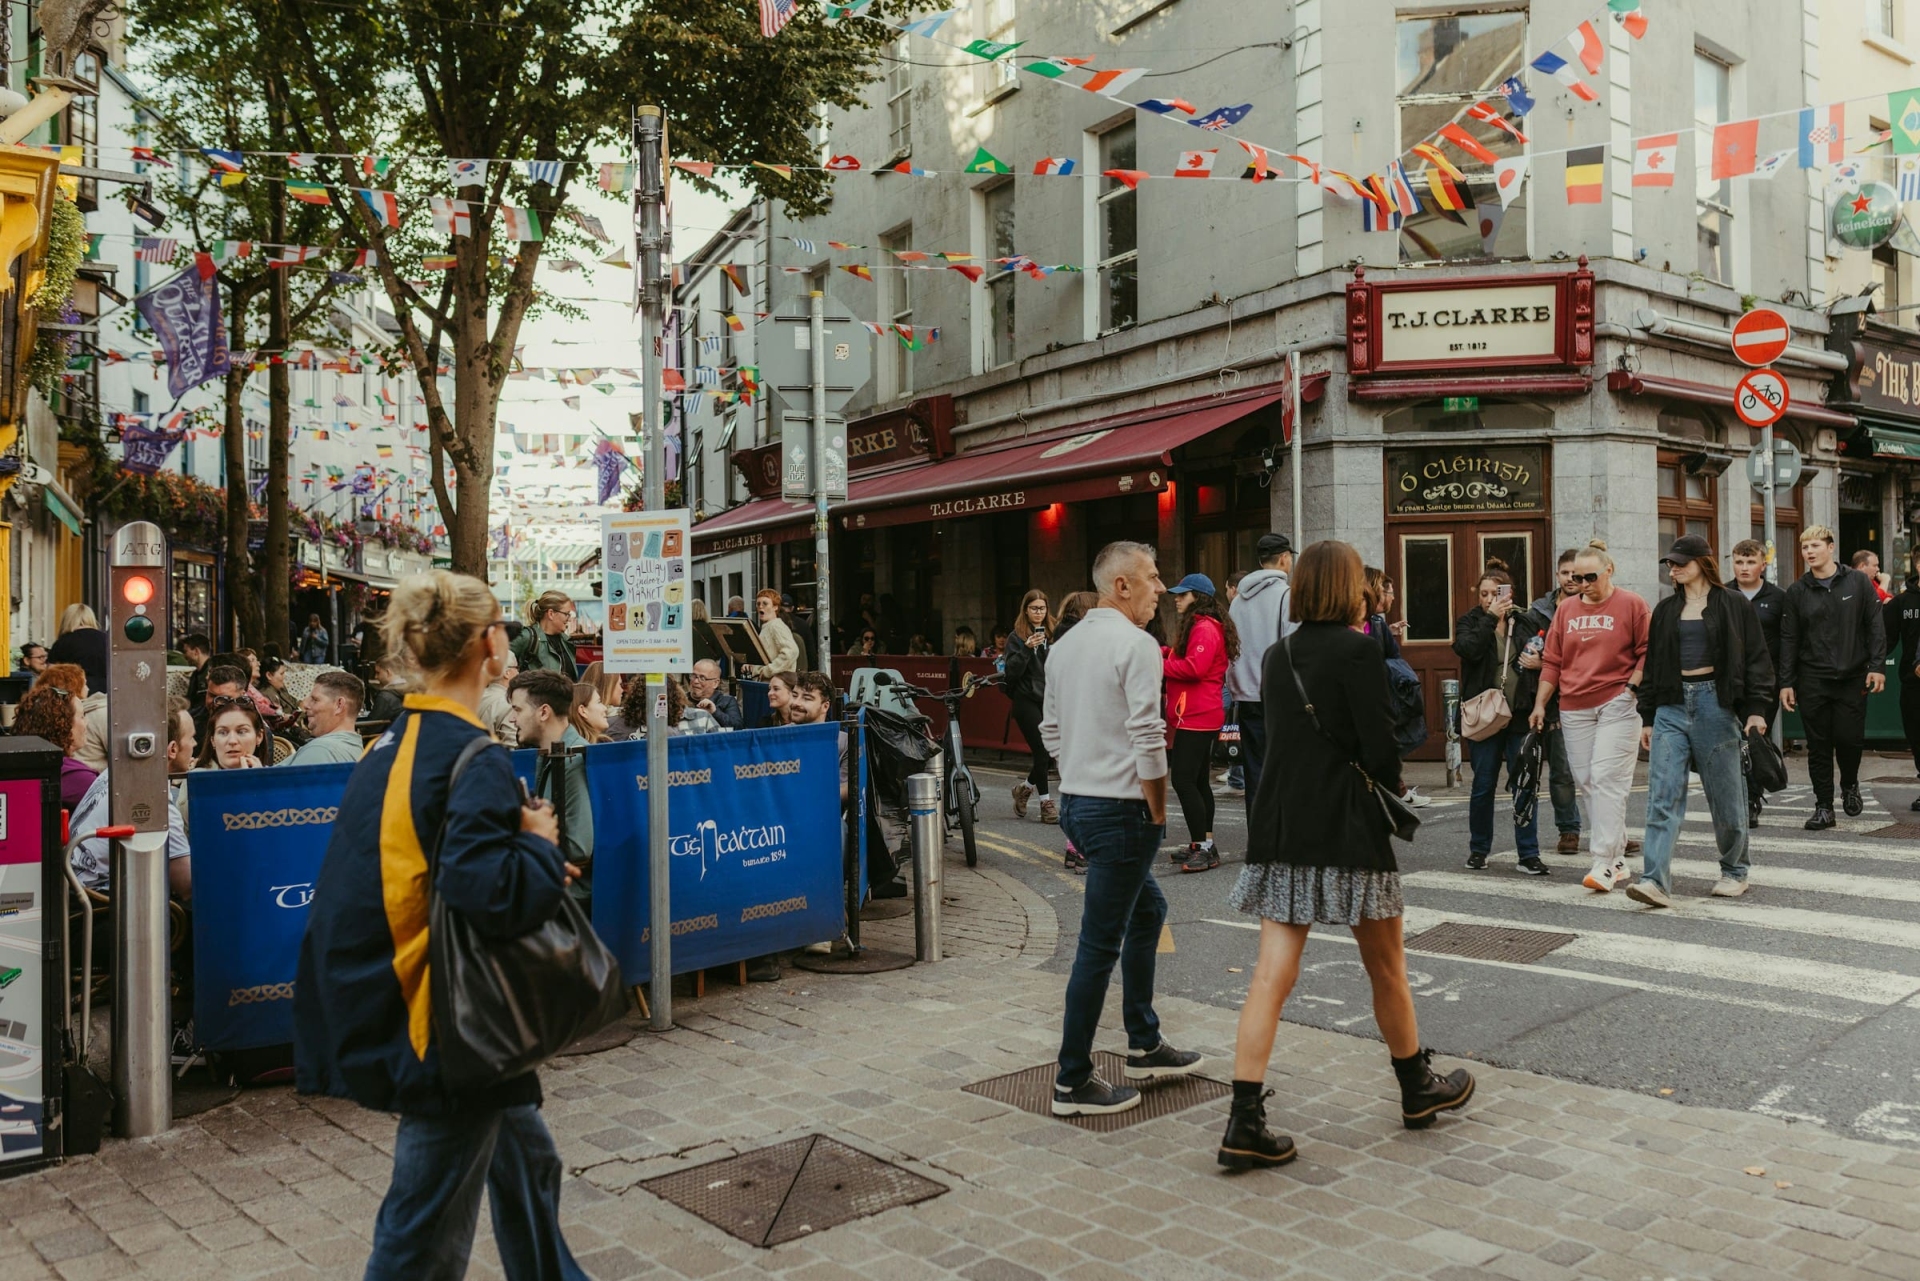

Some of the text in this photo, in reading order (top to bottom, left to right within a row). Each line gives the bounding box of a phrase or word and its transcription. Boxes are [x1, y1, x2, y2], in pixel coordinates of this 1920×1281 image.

[1836, 215, 1893, 235] Heineken
[179, 275, 198, 299] THE
[151, 283, 204, 386] QUARTER
[1450, 342, 1487, 351] EST. 1812
[1876, 351, 1909, 405] THE
[847, 428, 898, 458] RKE
[1400, 472, 1418, 492] Ó
[121, 542, 161, 556] ATG
[628, 585, 664, 603] MARKET
[1903, 608, 1920, 619] NI
[1566, 614, 1614, 634] NIKE
[131, 809, 151, 818] ATG
[771, 848, 787, 862] 1894
